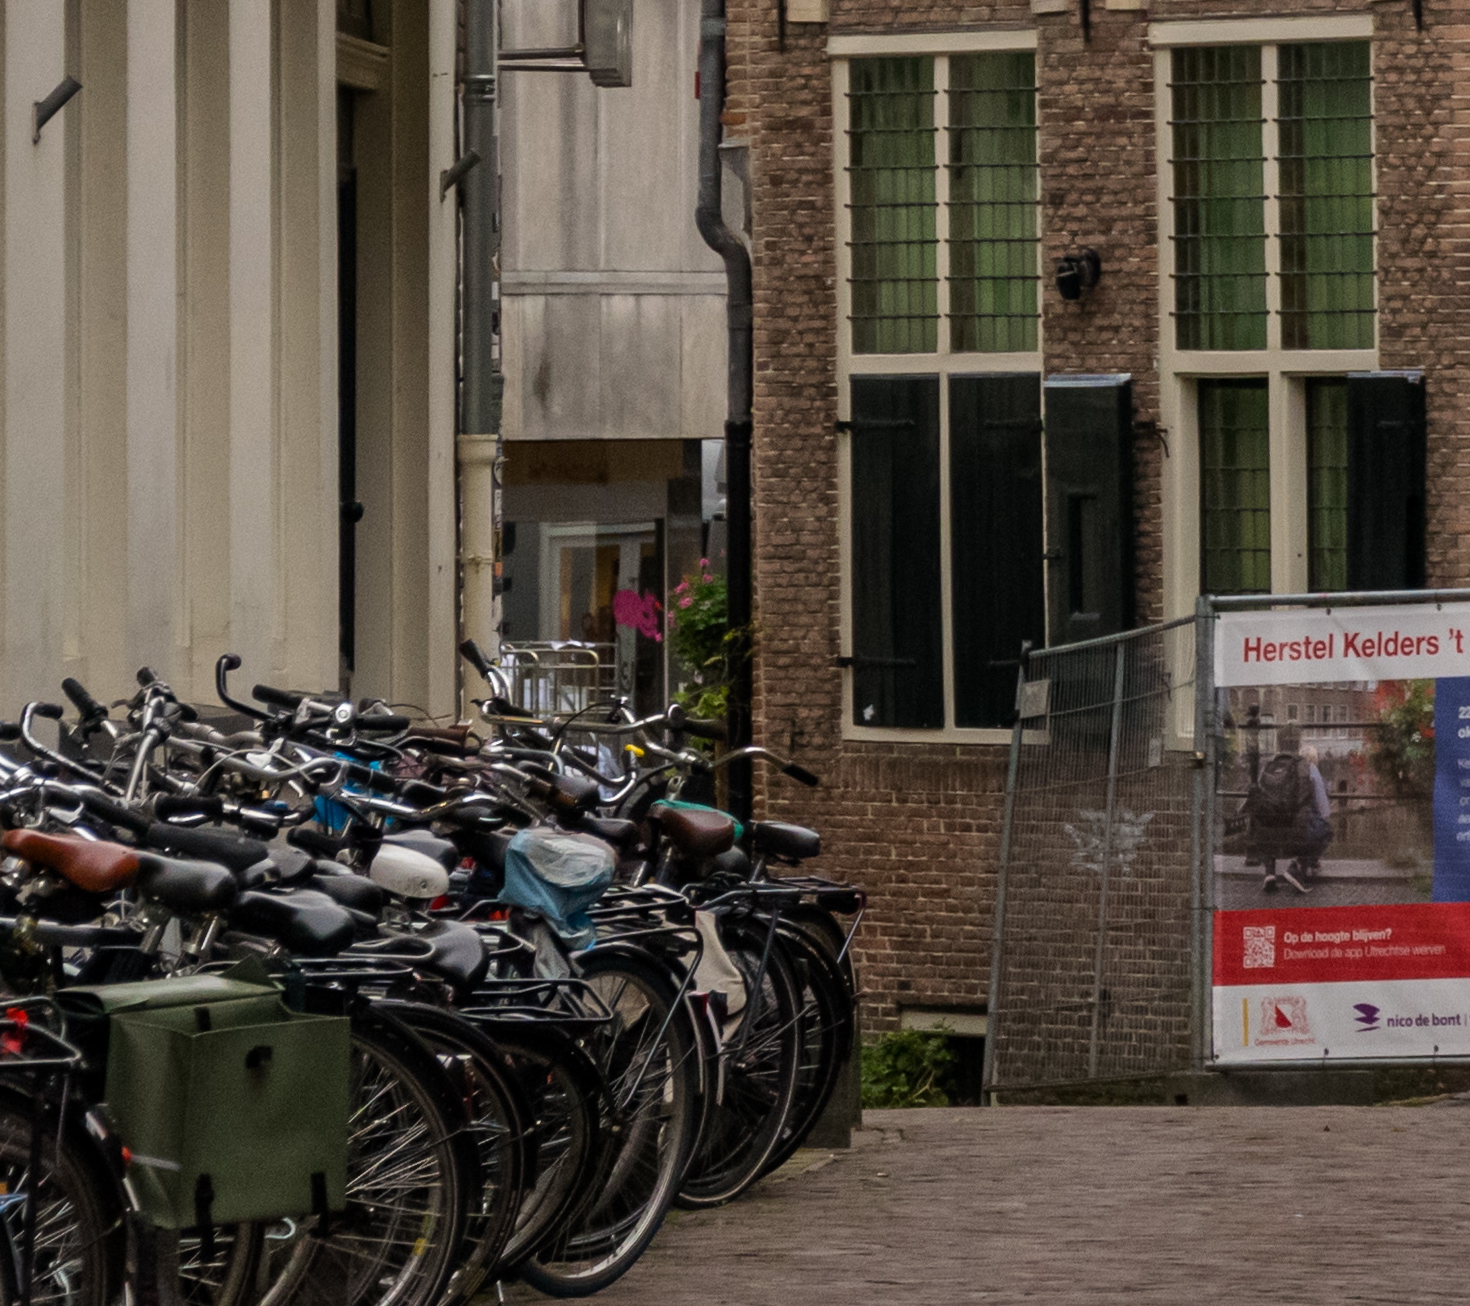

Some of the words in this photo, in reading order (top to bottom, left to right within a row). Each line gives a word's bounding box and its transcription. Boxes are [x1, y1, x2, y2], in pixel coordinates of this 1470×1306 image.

[1243, 633, 1333, 662] Herstel
[1343, 631, 1439, 658] Kelders
[1284, 931, 1299, 944] Op
[1301, 931, 1313, 943] de
[1315, 930, 1350, 944] hoogte
[1352, 928, 1392, 942] blijven?
[1284, 947, 1329, 960] Download
[1332, 946, 1343, 958] de
[1344, 947, 1363, 960] app
[1365, 944, 1410, 958] Utrechtse
[1412, 944, 1446, 956] werven
[1387, 1015, 1413, 1027] nico
[1415, 1014, 1430, 1026] de
[1432, 1013, 1461, 1026] bont
